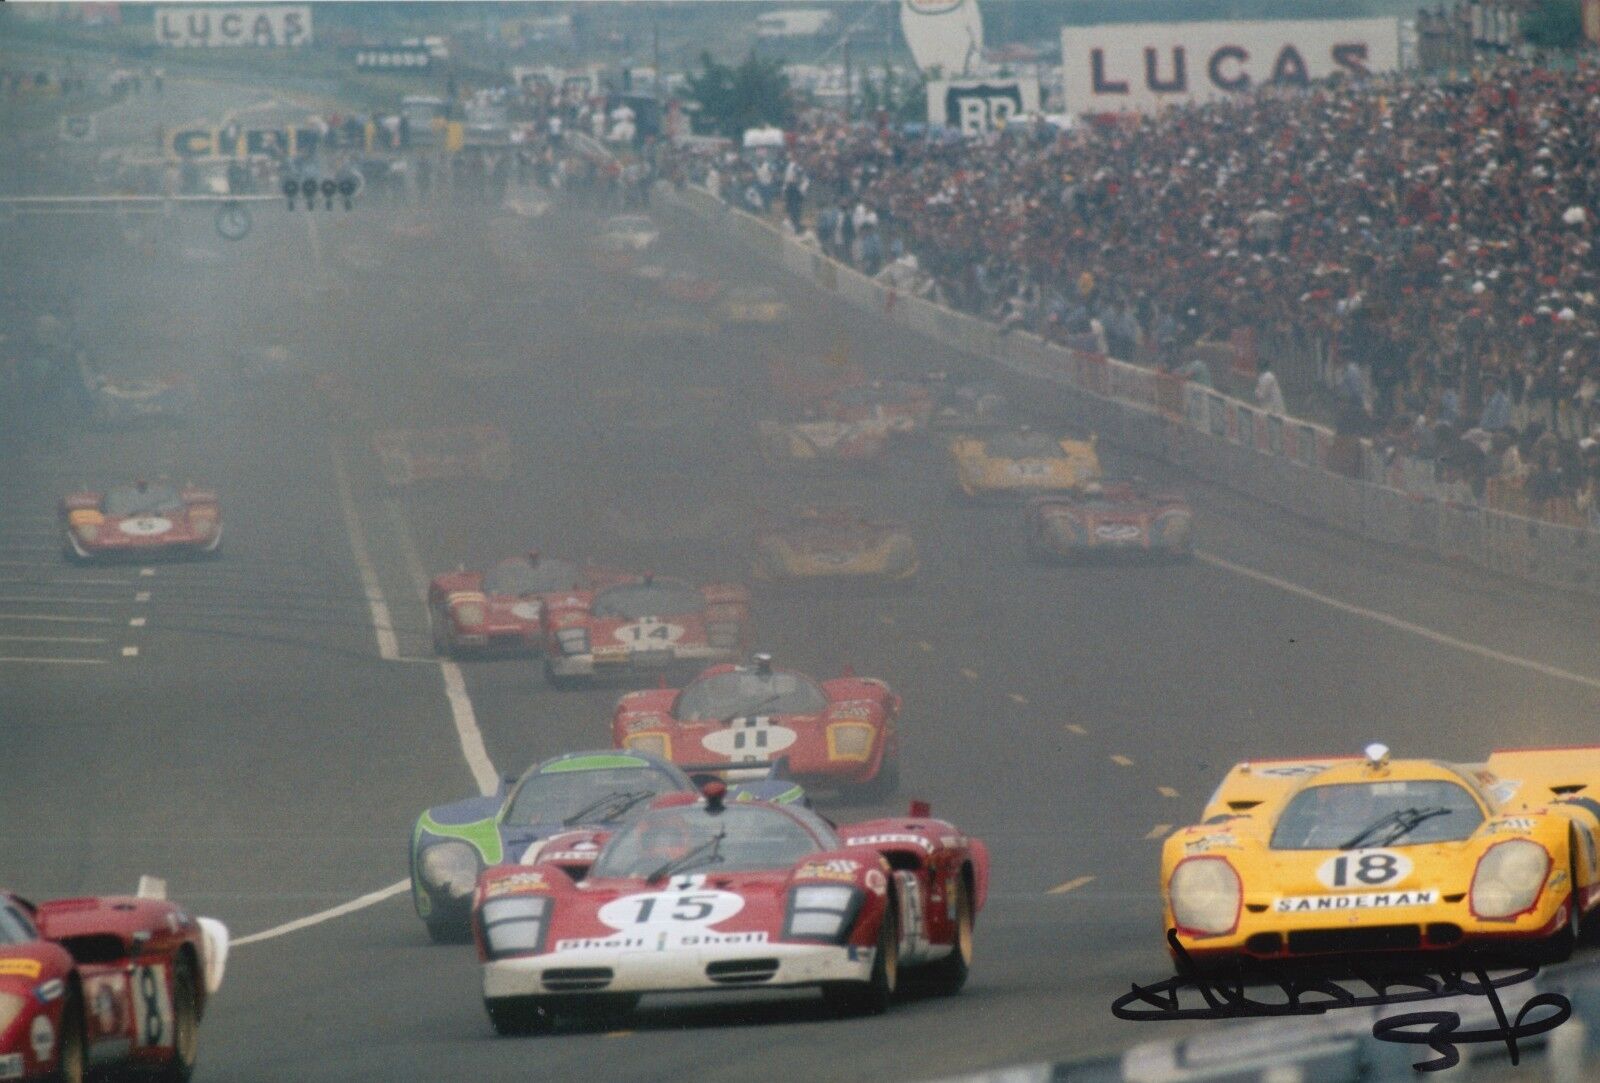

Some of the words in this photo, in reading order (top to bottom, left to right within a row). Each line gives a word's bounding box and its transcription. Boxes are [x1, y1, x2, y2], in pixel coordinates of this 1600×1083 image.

[161, 13, 303, 42] LUCAS
[1090, 43, 1370, 95] LUCAS
[628, 625, 669, 641] 14
[734, 730, 767, 749] 11
[1333, 853, 1398, 887] 18
[634, 895, 717, 923] 15
[1278, 892, 1431, 912] SANDEMAN
[561, 938, 643, 949] Shell
[680, 933, 764, 946] Shell
[141, 964, 163, 1046] 8
